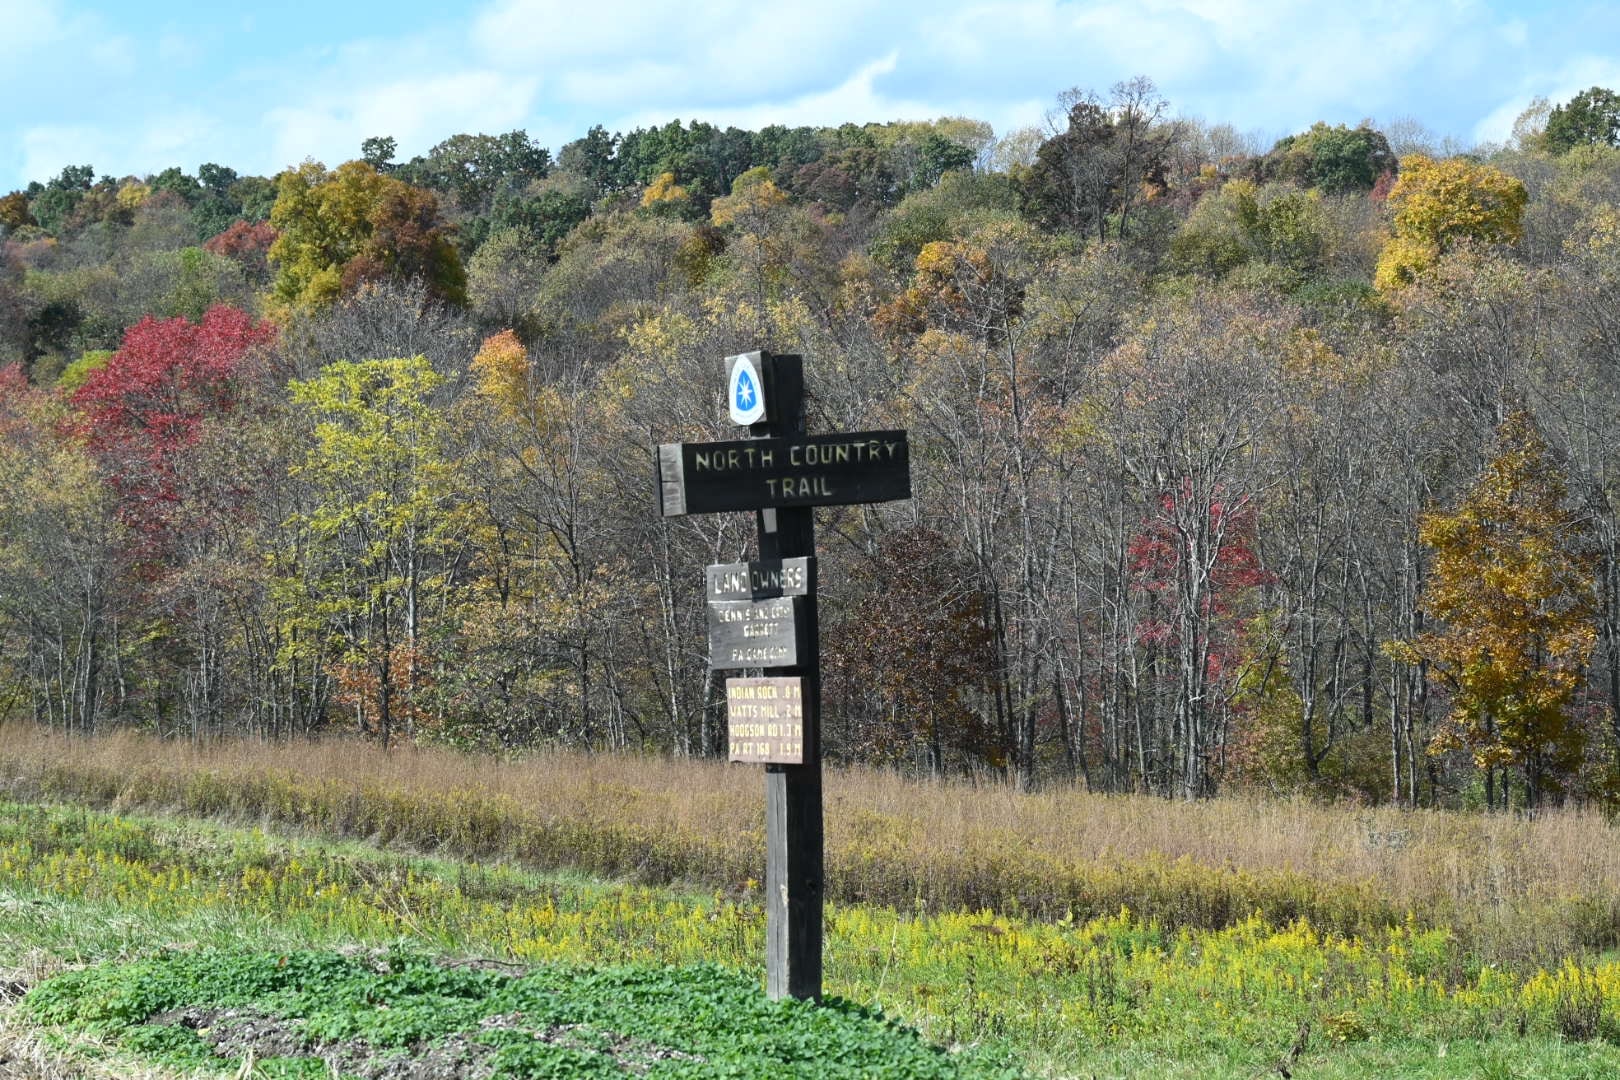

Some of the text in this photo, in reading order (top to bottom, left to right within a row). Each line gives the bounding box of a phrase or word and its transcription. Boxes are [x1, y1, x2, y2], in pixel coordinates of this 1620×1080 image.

[695, 440, 898, 472] NORTH COUNTRY
[766, 477, 833, 499] TRAIL
[718, 608, 752, 623] DENNIS
[754, 607, 769, 620] AND
[728, 686, 755, 699] INDIAN
[757, 686, 778, 699] ROCK
[729, 704, 758, 718] WATTS
[760, 704, 780, 718] MILL
[729, 723, 765, 737] HODGSON
[767, 724, 778, 737] RD
[729, 742, 740, 756] PA
[742, 742, 753, 756] RT
